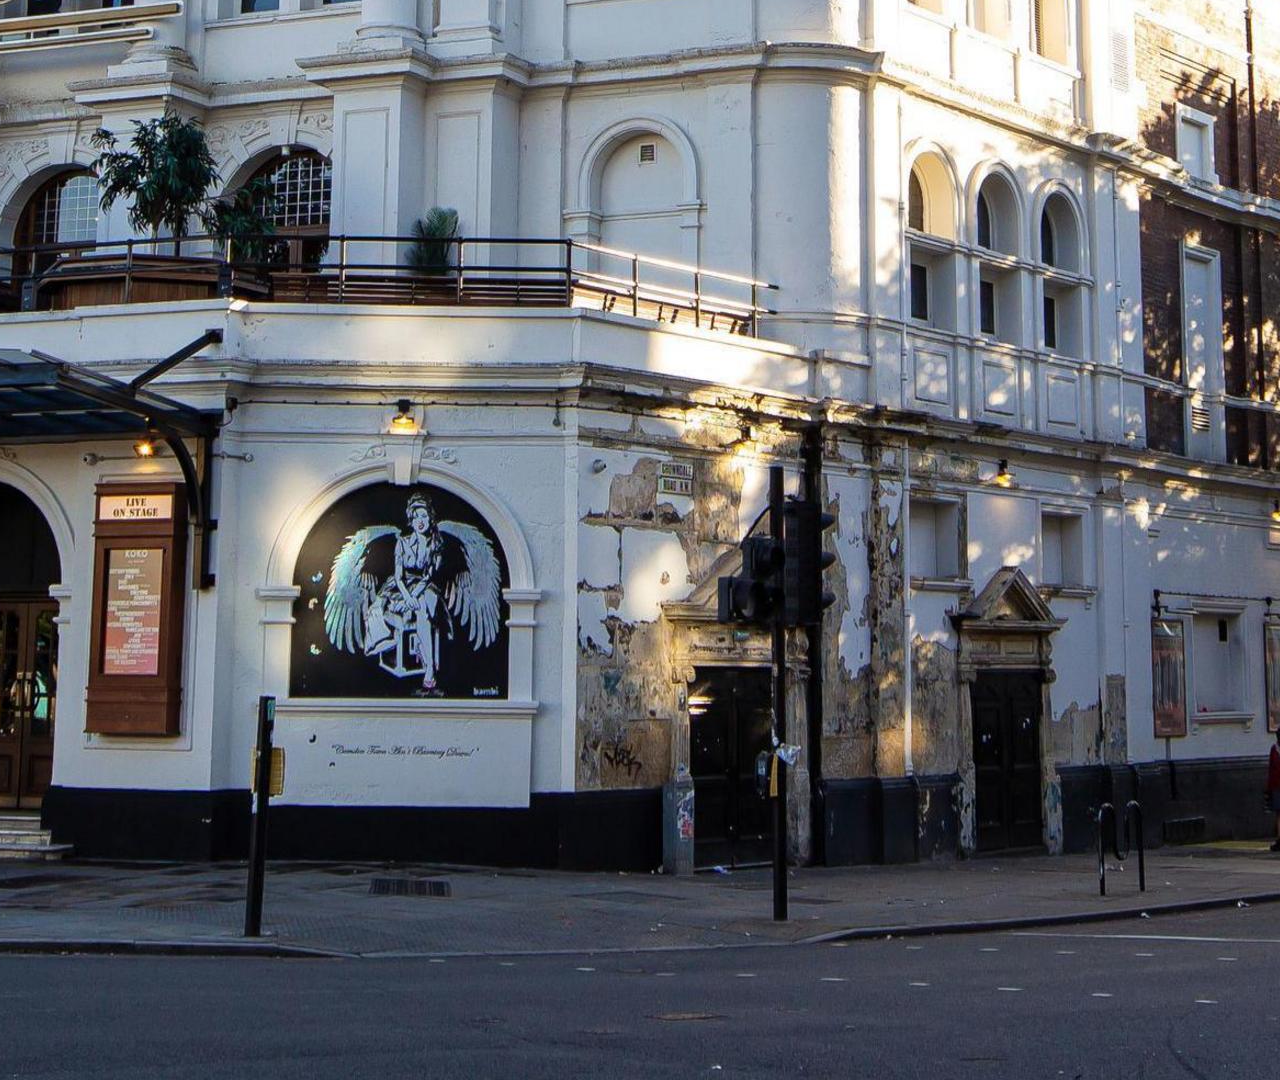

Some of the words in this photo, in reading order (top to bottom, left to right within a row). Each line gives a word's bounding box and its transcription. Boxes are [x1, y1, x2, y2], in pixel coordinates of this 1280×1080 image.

[126, 498, 147, 507] LIVE
[113, 508, 126, 518] ON
[129, 507, 159, 517] STAGE
[124, 550, 149, 559] KOKO
[472, 686, 500, 696] bambi
